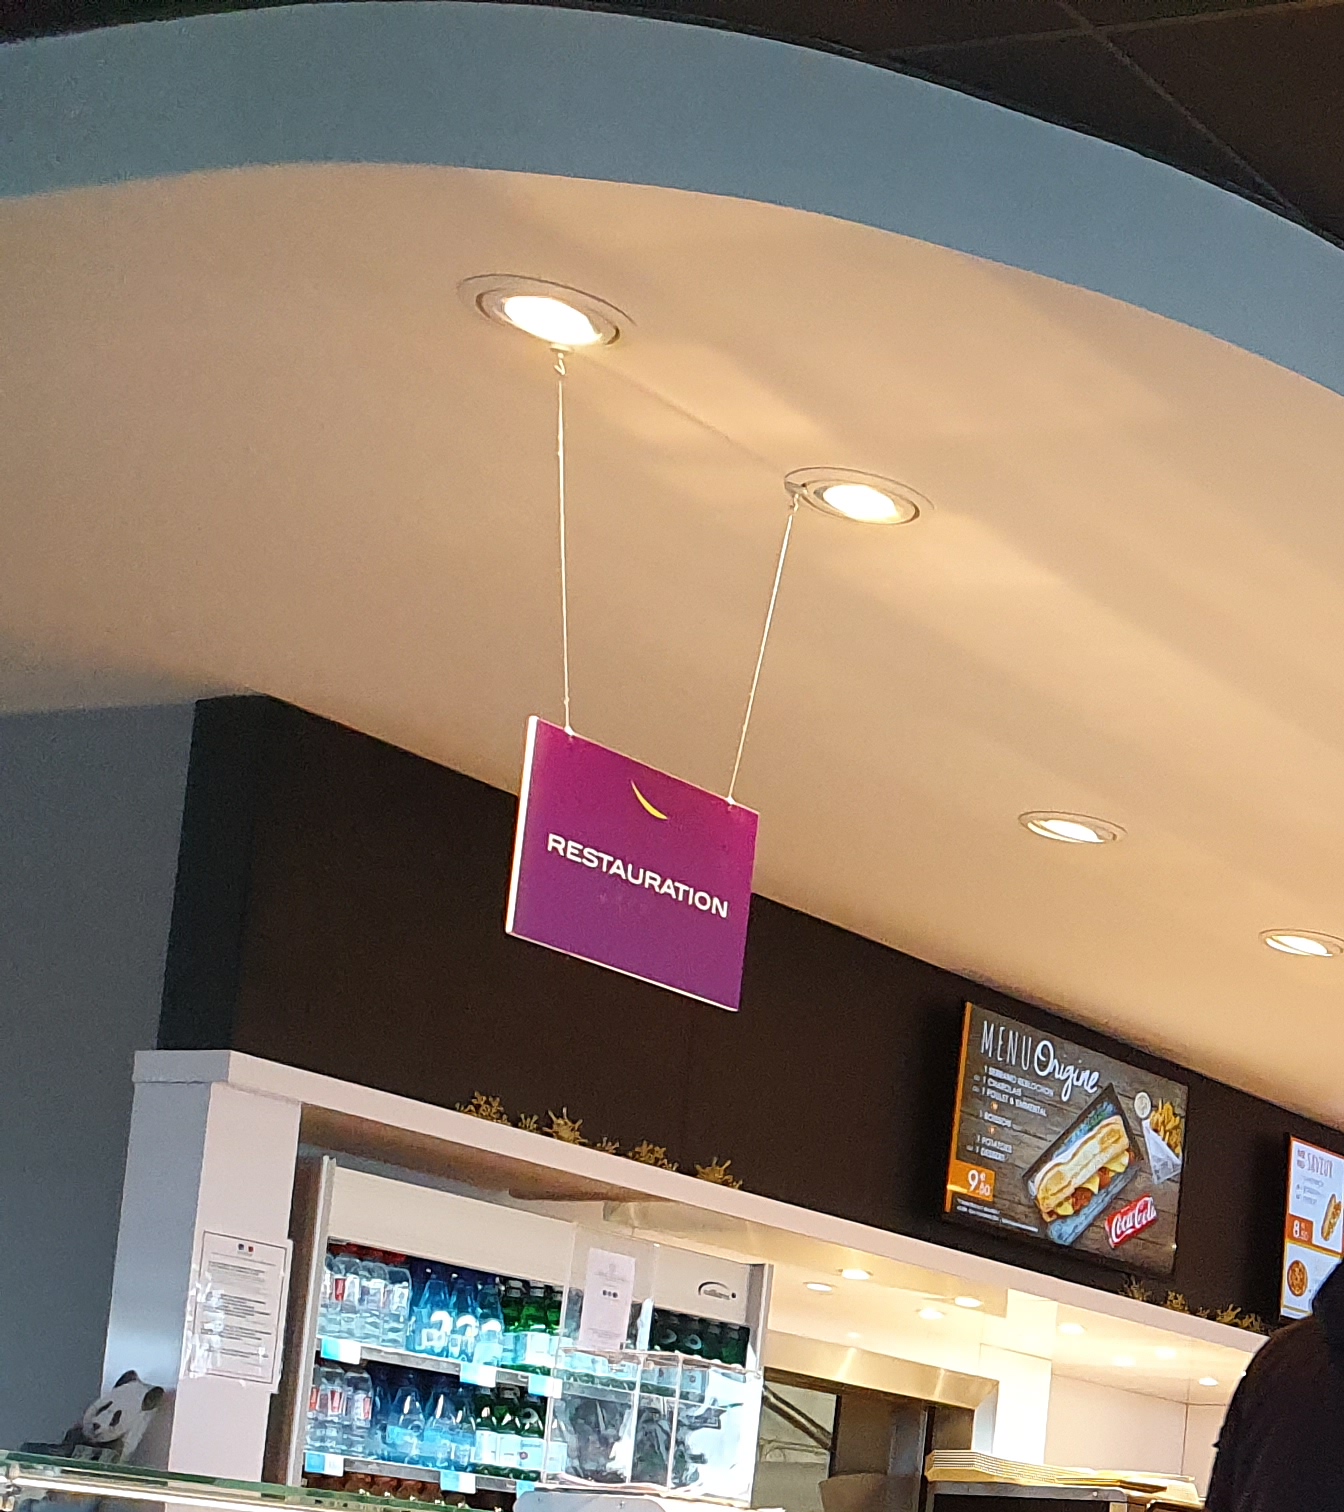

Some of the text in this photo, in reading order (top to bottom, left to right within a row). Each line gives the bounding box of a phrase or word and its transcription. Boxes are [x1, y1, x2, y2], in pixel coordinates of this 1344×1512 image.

[547, 832, 728, 918] RESTAURATION
[980, 1020, 1100, 1102] MENU Origine
